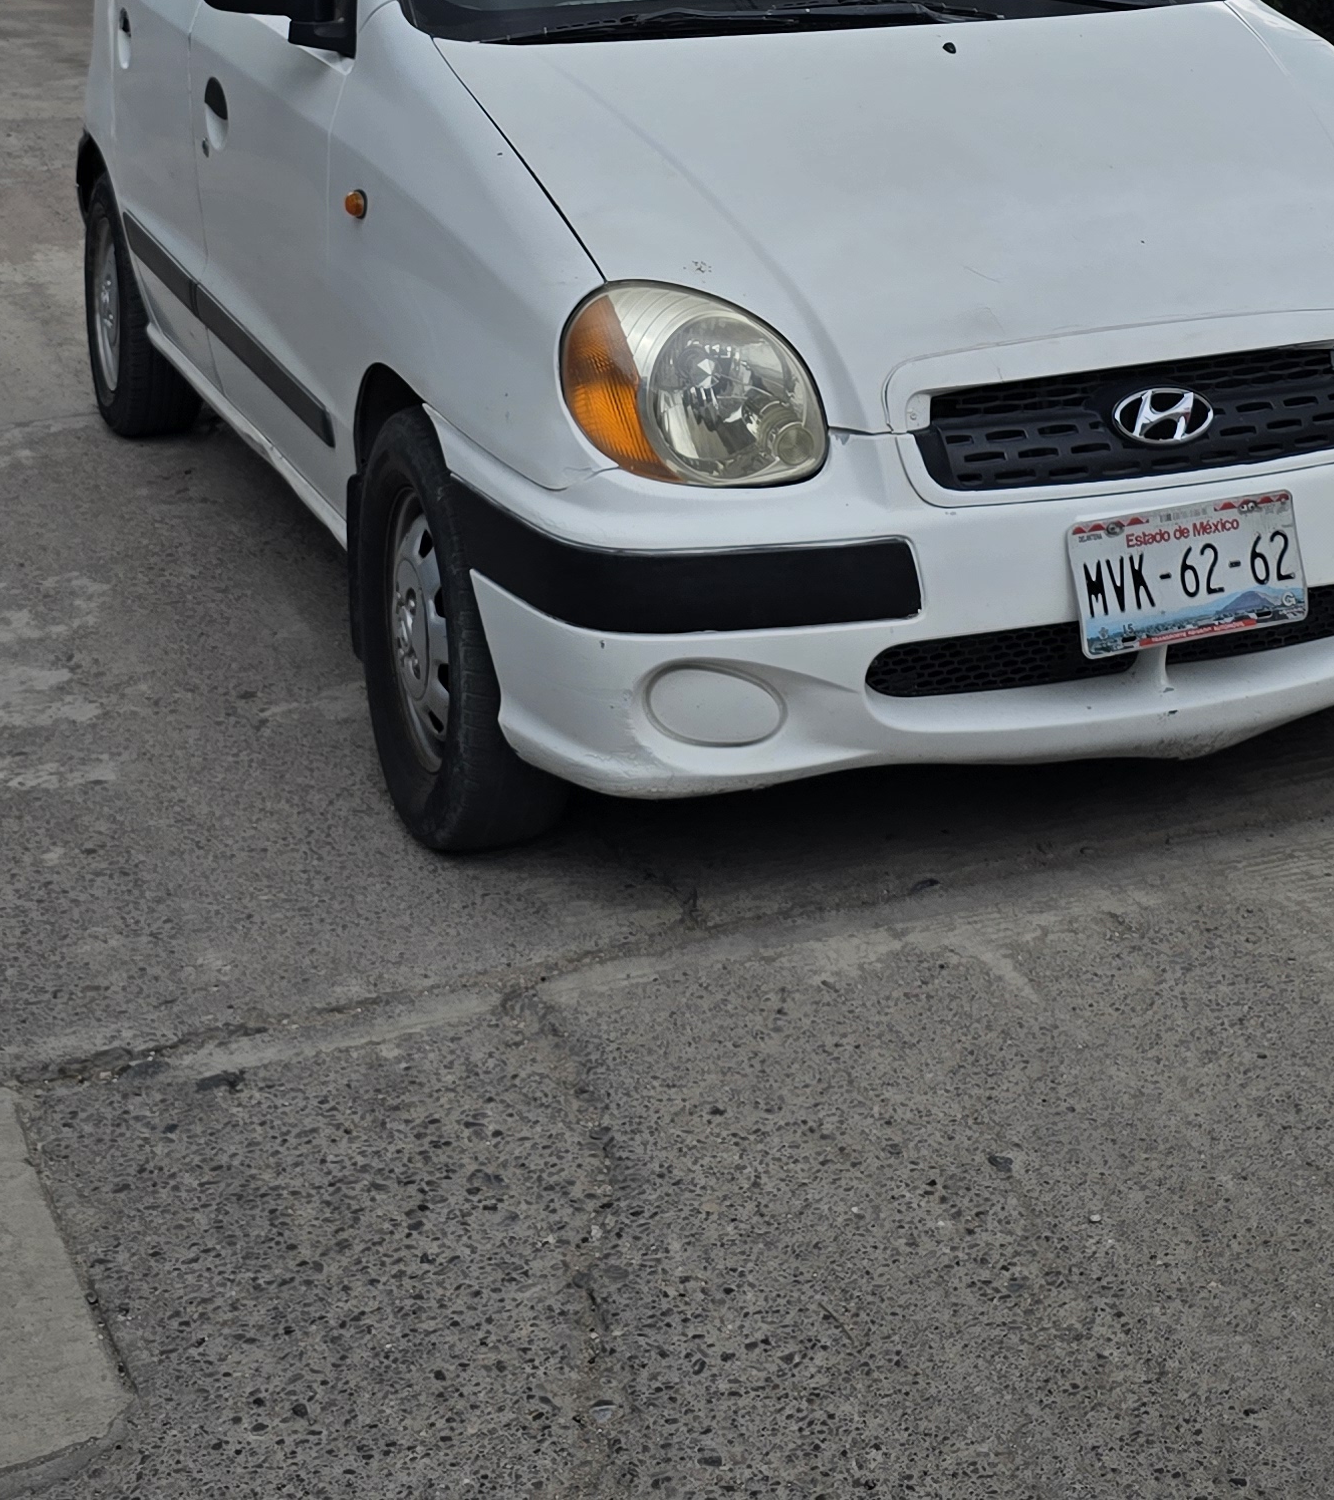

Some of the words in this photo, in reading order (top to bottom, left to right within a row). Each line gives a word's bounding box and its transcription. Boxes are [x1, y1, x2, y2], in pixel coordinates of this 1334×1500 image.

[1125, 526, 1171, 548] Estado
[1173, 524, 1190, 540] de
[1192, 518, 1240, 537] México
[1083, 530, 1296, 618] MVK-62-62
